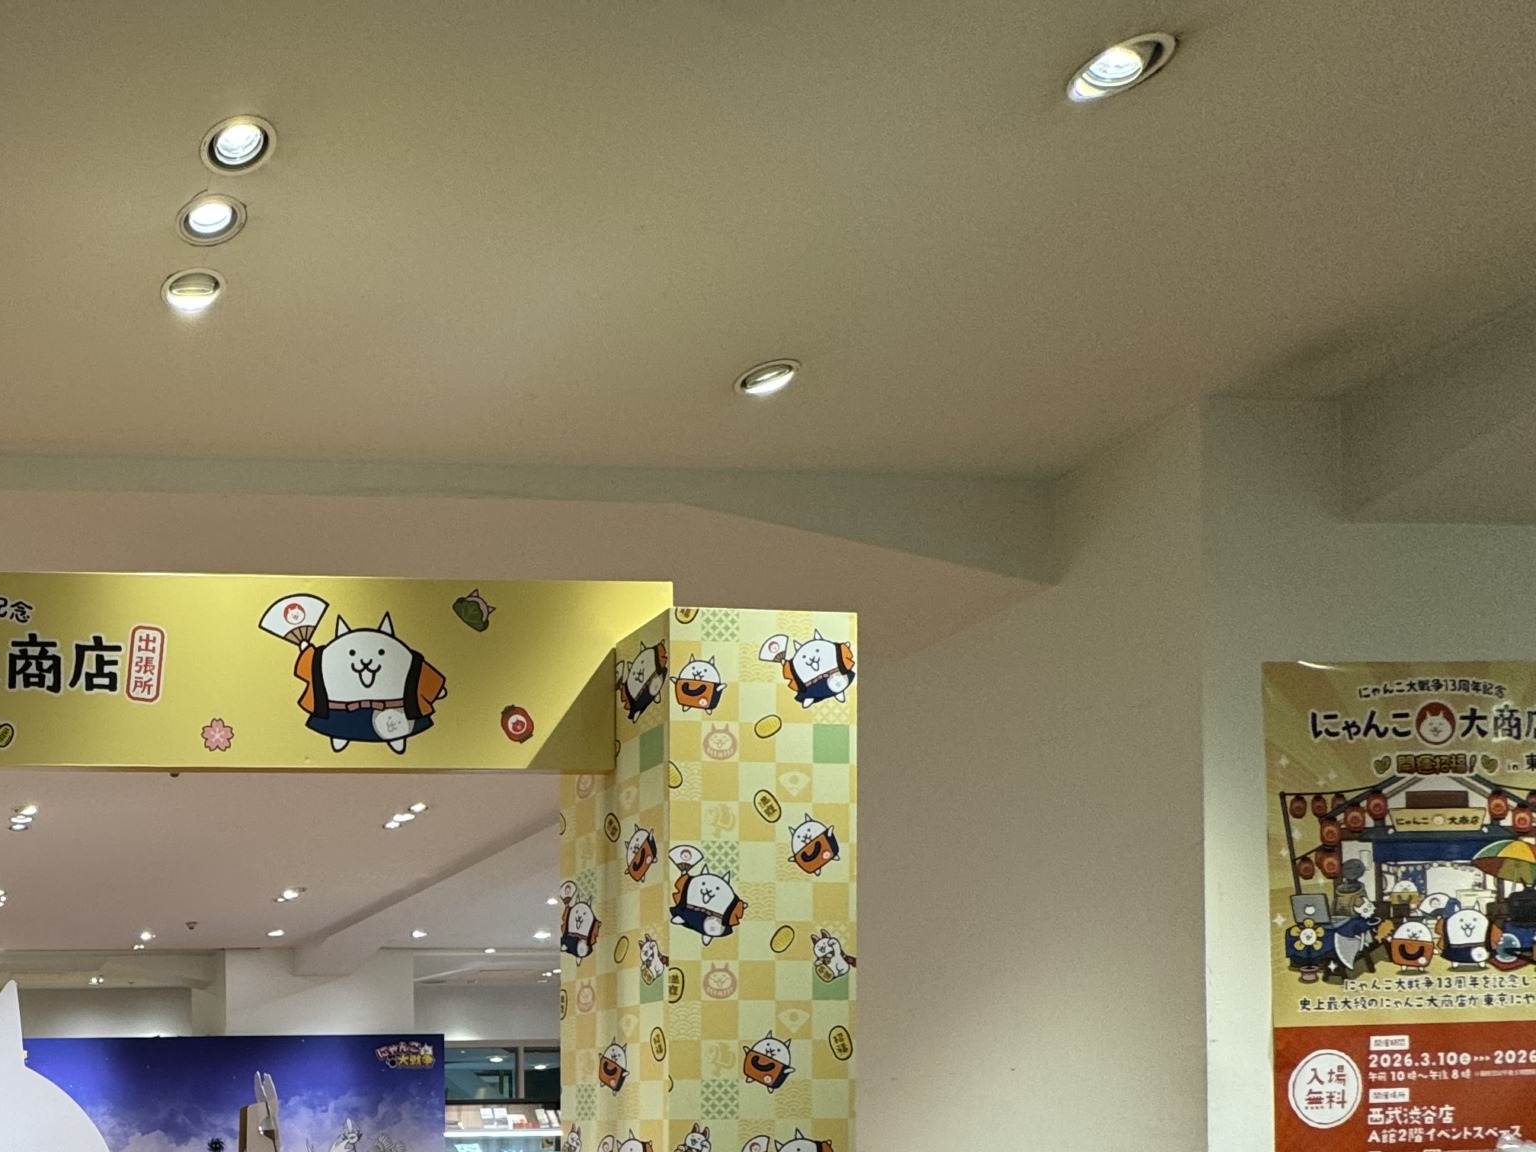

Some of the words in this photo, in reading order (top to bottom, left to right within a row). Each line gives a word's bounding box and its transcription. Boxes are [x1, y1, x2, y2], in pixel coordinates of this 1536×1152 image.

[133, 633, 156, 695] 出張所
[1359, 679, 1507, 699] にゃんこ大戦争13周年記念
[1311, 711, 1412, 740] にゃんこ
[1345, 975, 1536, 991] にゃんこ大戦争13周年を記念し
[1306, 1065, 1347, 1086] 入場
[1305, 1089, 1347, 1109] 無料
[1368, 1105, 1455, 1125] 西武渋谷店
